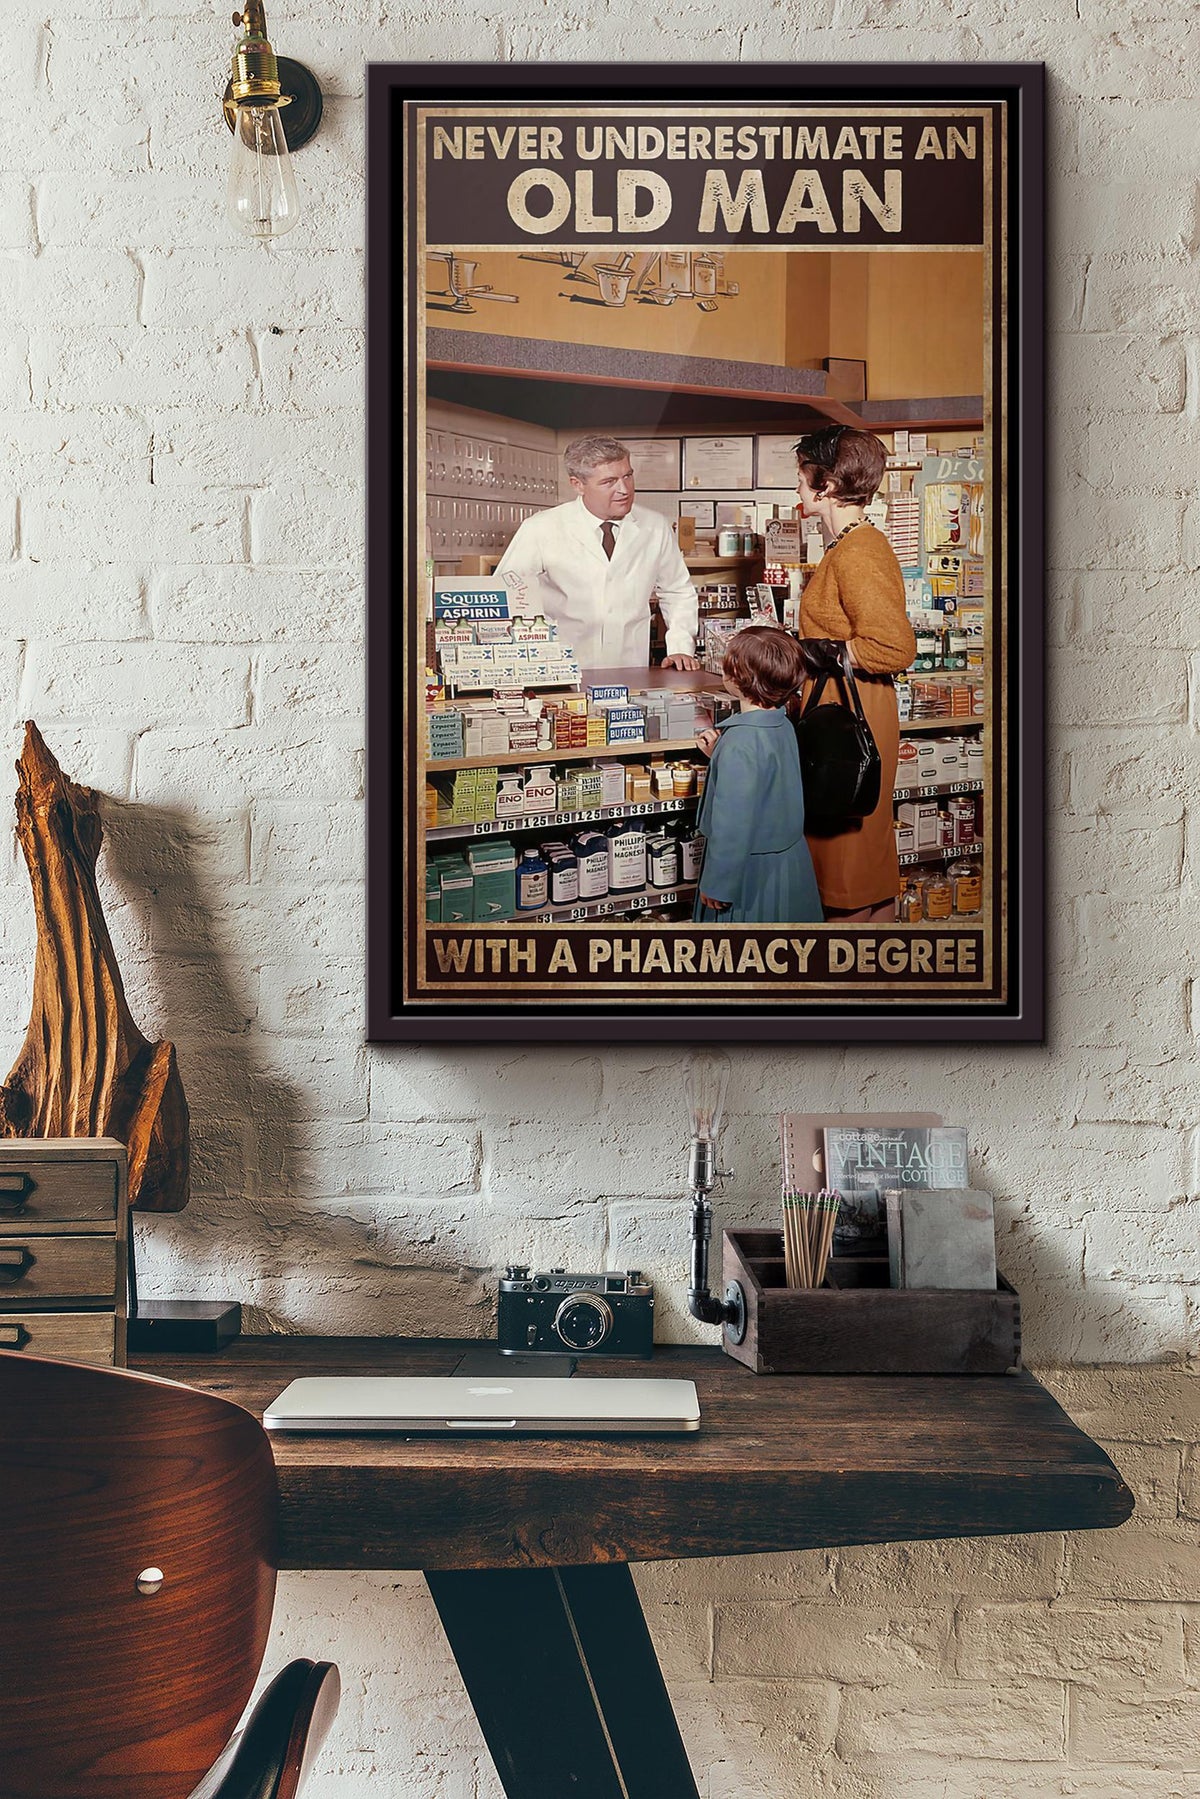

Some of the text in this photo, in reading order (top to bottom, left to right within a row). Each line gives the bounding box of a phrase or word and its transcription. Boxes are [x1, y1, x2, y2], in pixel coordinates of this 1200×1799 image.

[433, 126, 977, 160] NEVER UNDERESTIMATE AN
[507, 168, 902, 234] OLD MAN
[440, 593, 499, 606] SQUIBB
[442, 607, 500, 619] ASPIRIN
[439, 635, 470, 643] ASPIRIN
[593, 688, 627, 699] BUFFERIN
[611, 709, 644, 721] BUFFERIN
[610, 727, 644, 739] BUFFERIN
[525, 787, 555, 798] ENO
[498, 795, 522, 804] ENO
[556, 813, 570, 823] 69
[608, 808, 622, 817] 63
[475, 822, 491, 834] 50
[501, 821, 514, 830] 75
[614, 836, 645, 847] PHILLIPS
[614, 849, 645, 858] MAGNESIA
[586, 856, 607, 865] PHILLIP
[586, 866, 607, 874] MAGNES
[632, 898, 647, 908] 93
[662, 893, 676, 903] 30
[573, 908, 586, 918] 30
[599, 904, 614, 914] 59
[432, 938, 977, 973] WITH A PHARMACY DEGREE
[839, 1132, 880, 1143] cottage
[832, 1142, 965, 1169] VINTAGE
[902, 1169, 964, 1182] COTTAGE
